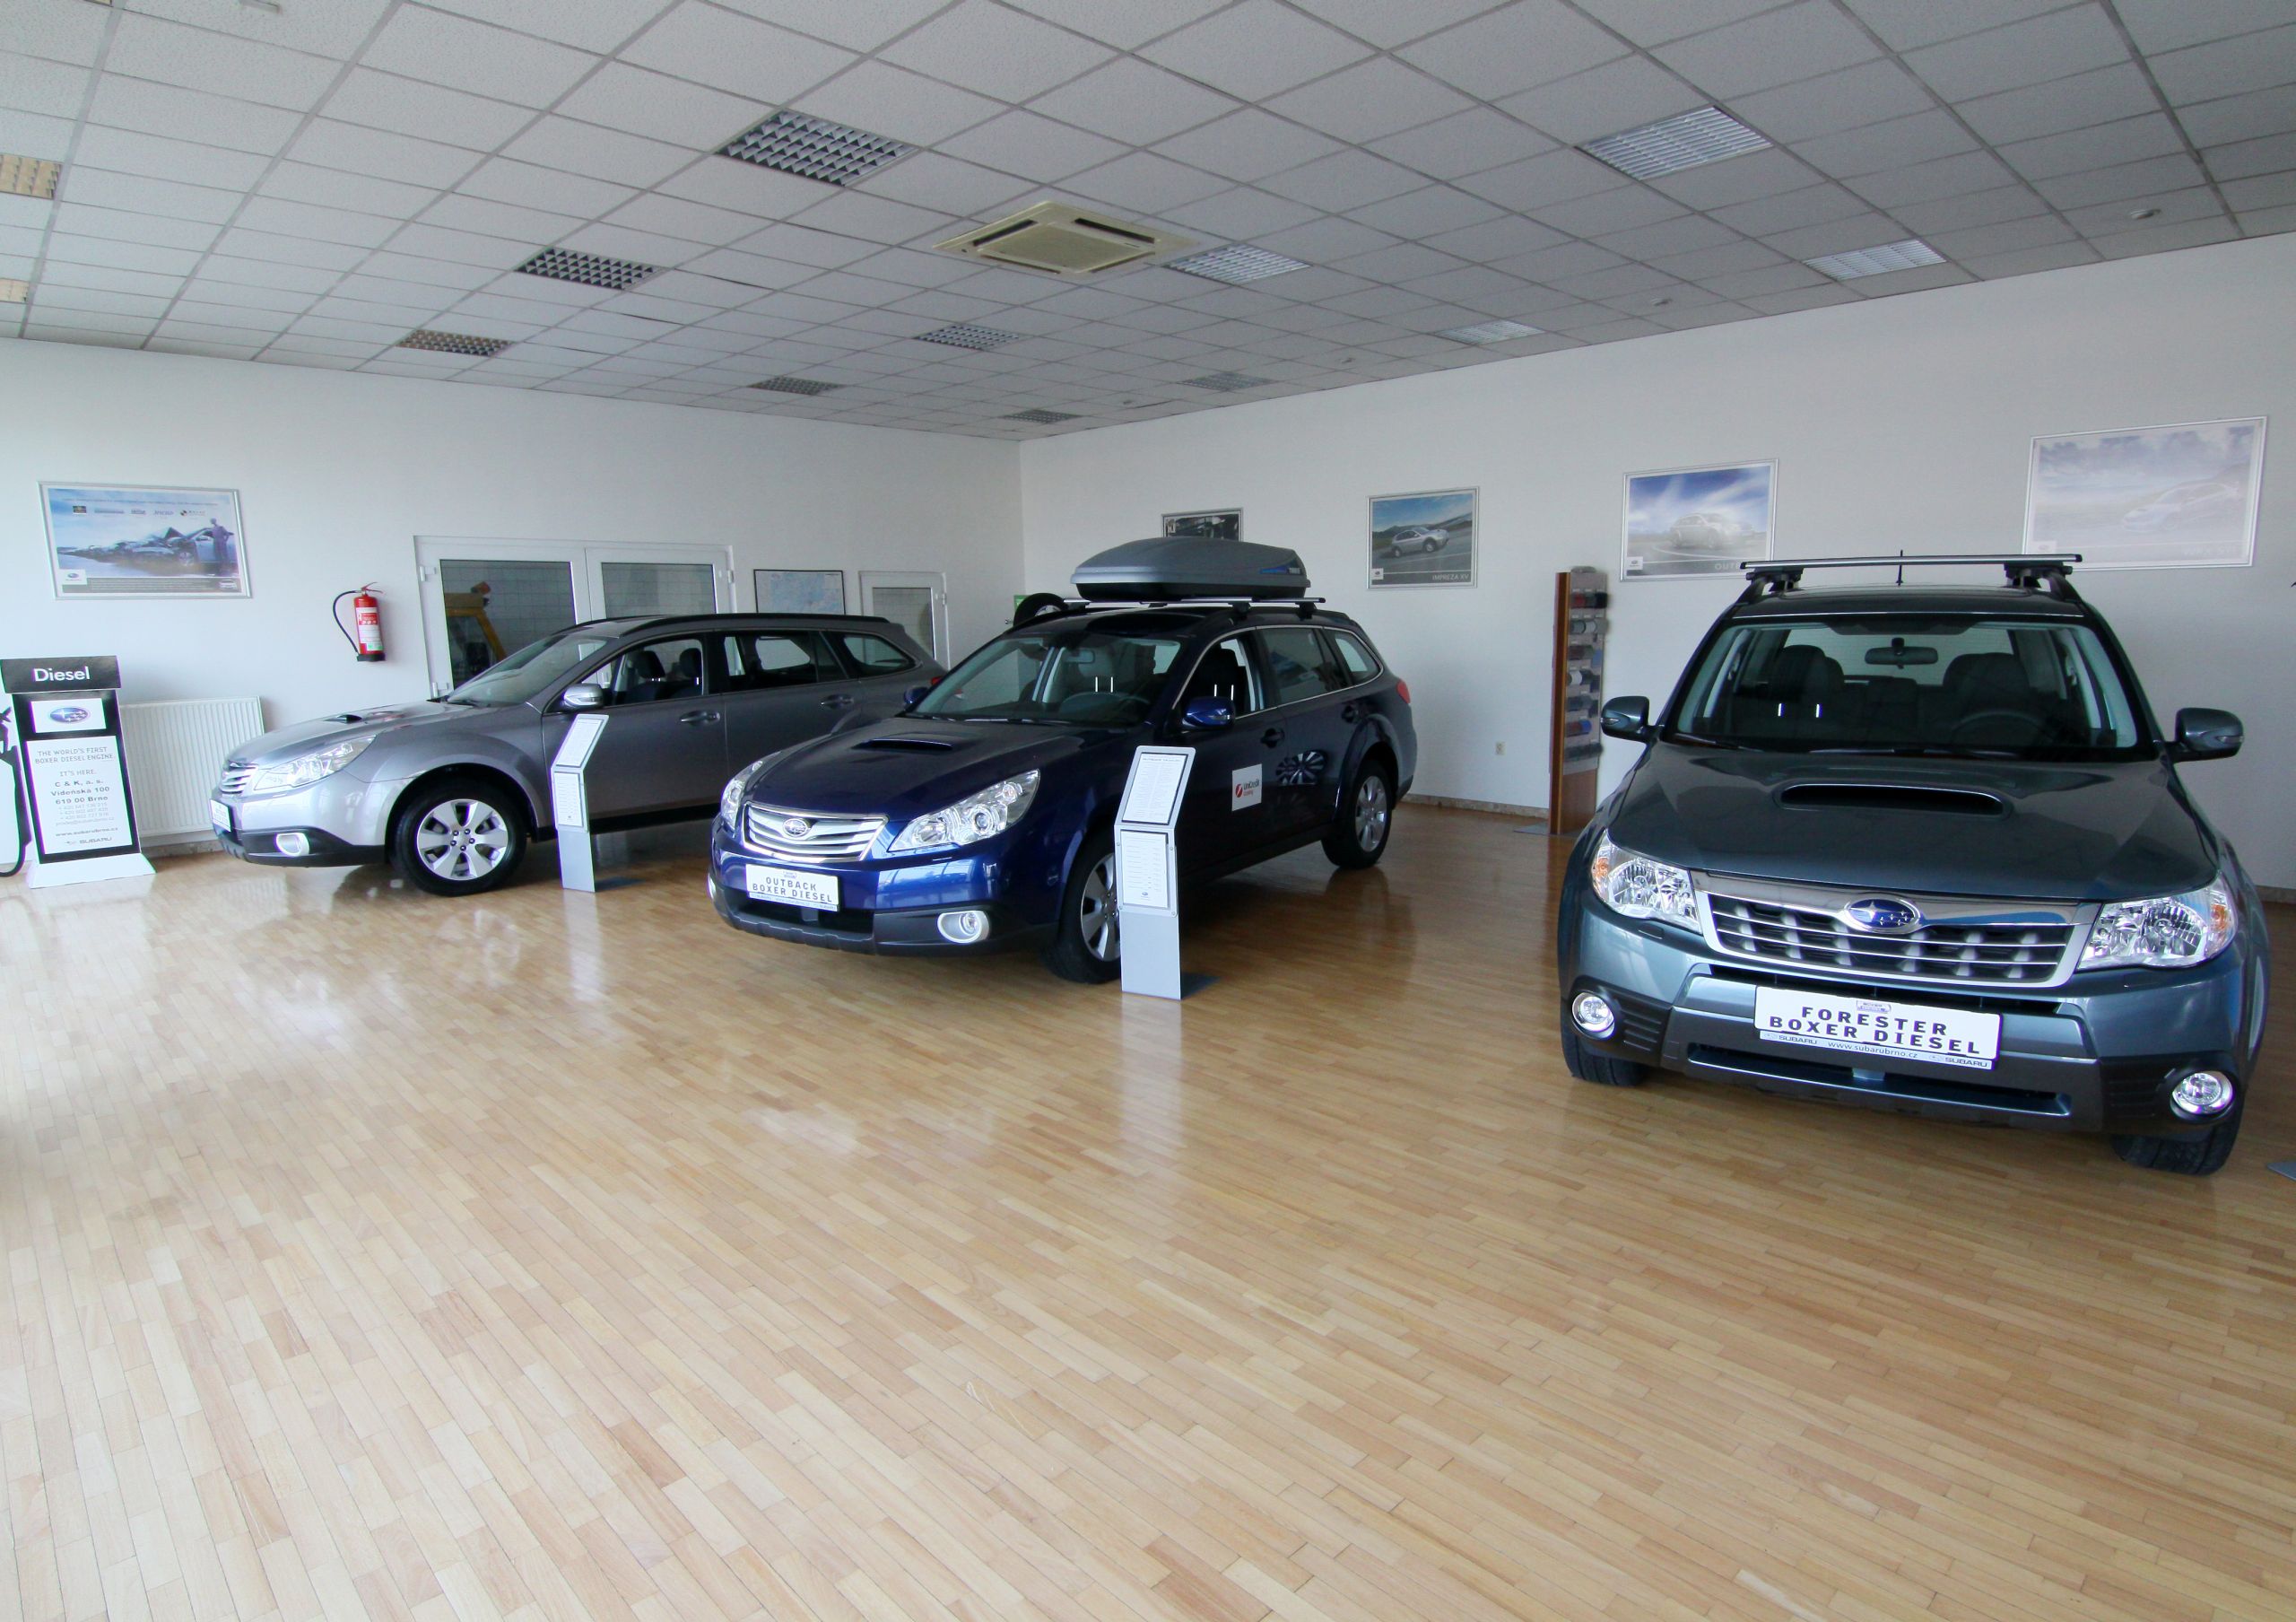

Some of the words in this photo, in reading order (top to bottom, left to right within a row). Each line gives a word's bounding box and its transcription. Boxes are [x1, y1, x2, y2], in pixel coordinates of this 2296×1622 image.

[33, 666, 91, 682] Diesel
[54, 747, 85, 755] WORLD'S
[752, 883, 787, 895] BOXER
[792, 889, 832, 903] DIESEL
[766, 876, 817, 891] OUTBACK
[1801, 1006, 1947, 1036] FORESTER
[1770, 1016, 1857, 1039] BOXER
[1874, 1030, 1980, 1055] DIESEL
[1779, 1034, 1817, 1045] SUBARU
[1828, 1041, 1918, 1059] www.subarubrno.cz
[1944, 1057, 1988, 1068] SUBARU
